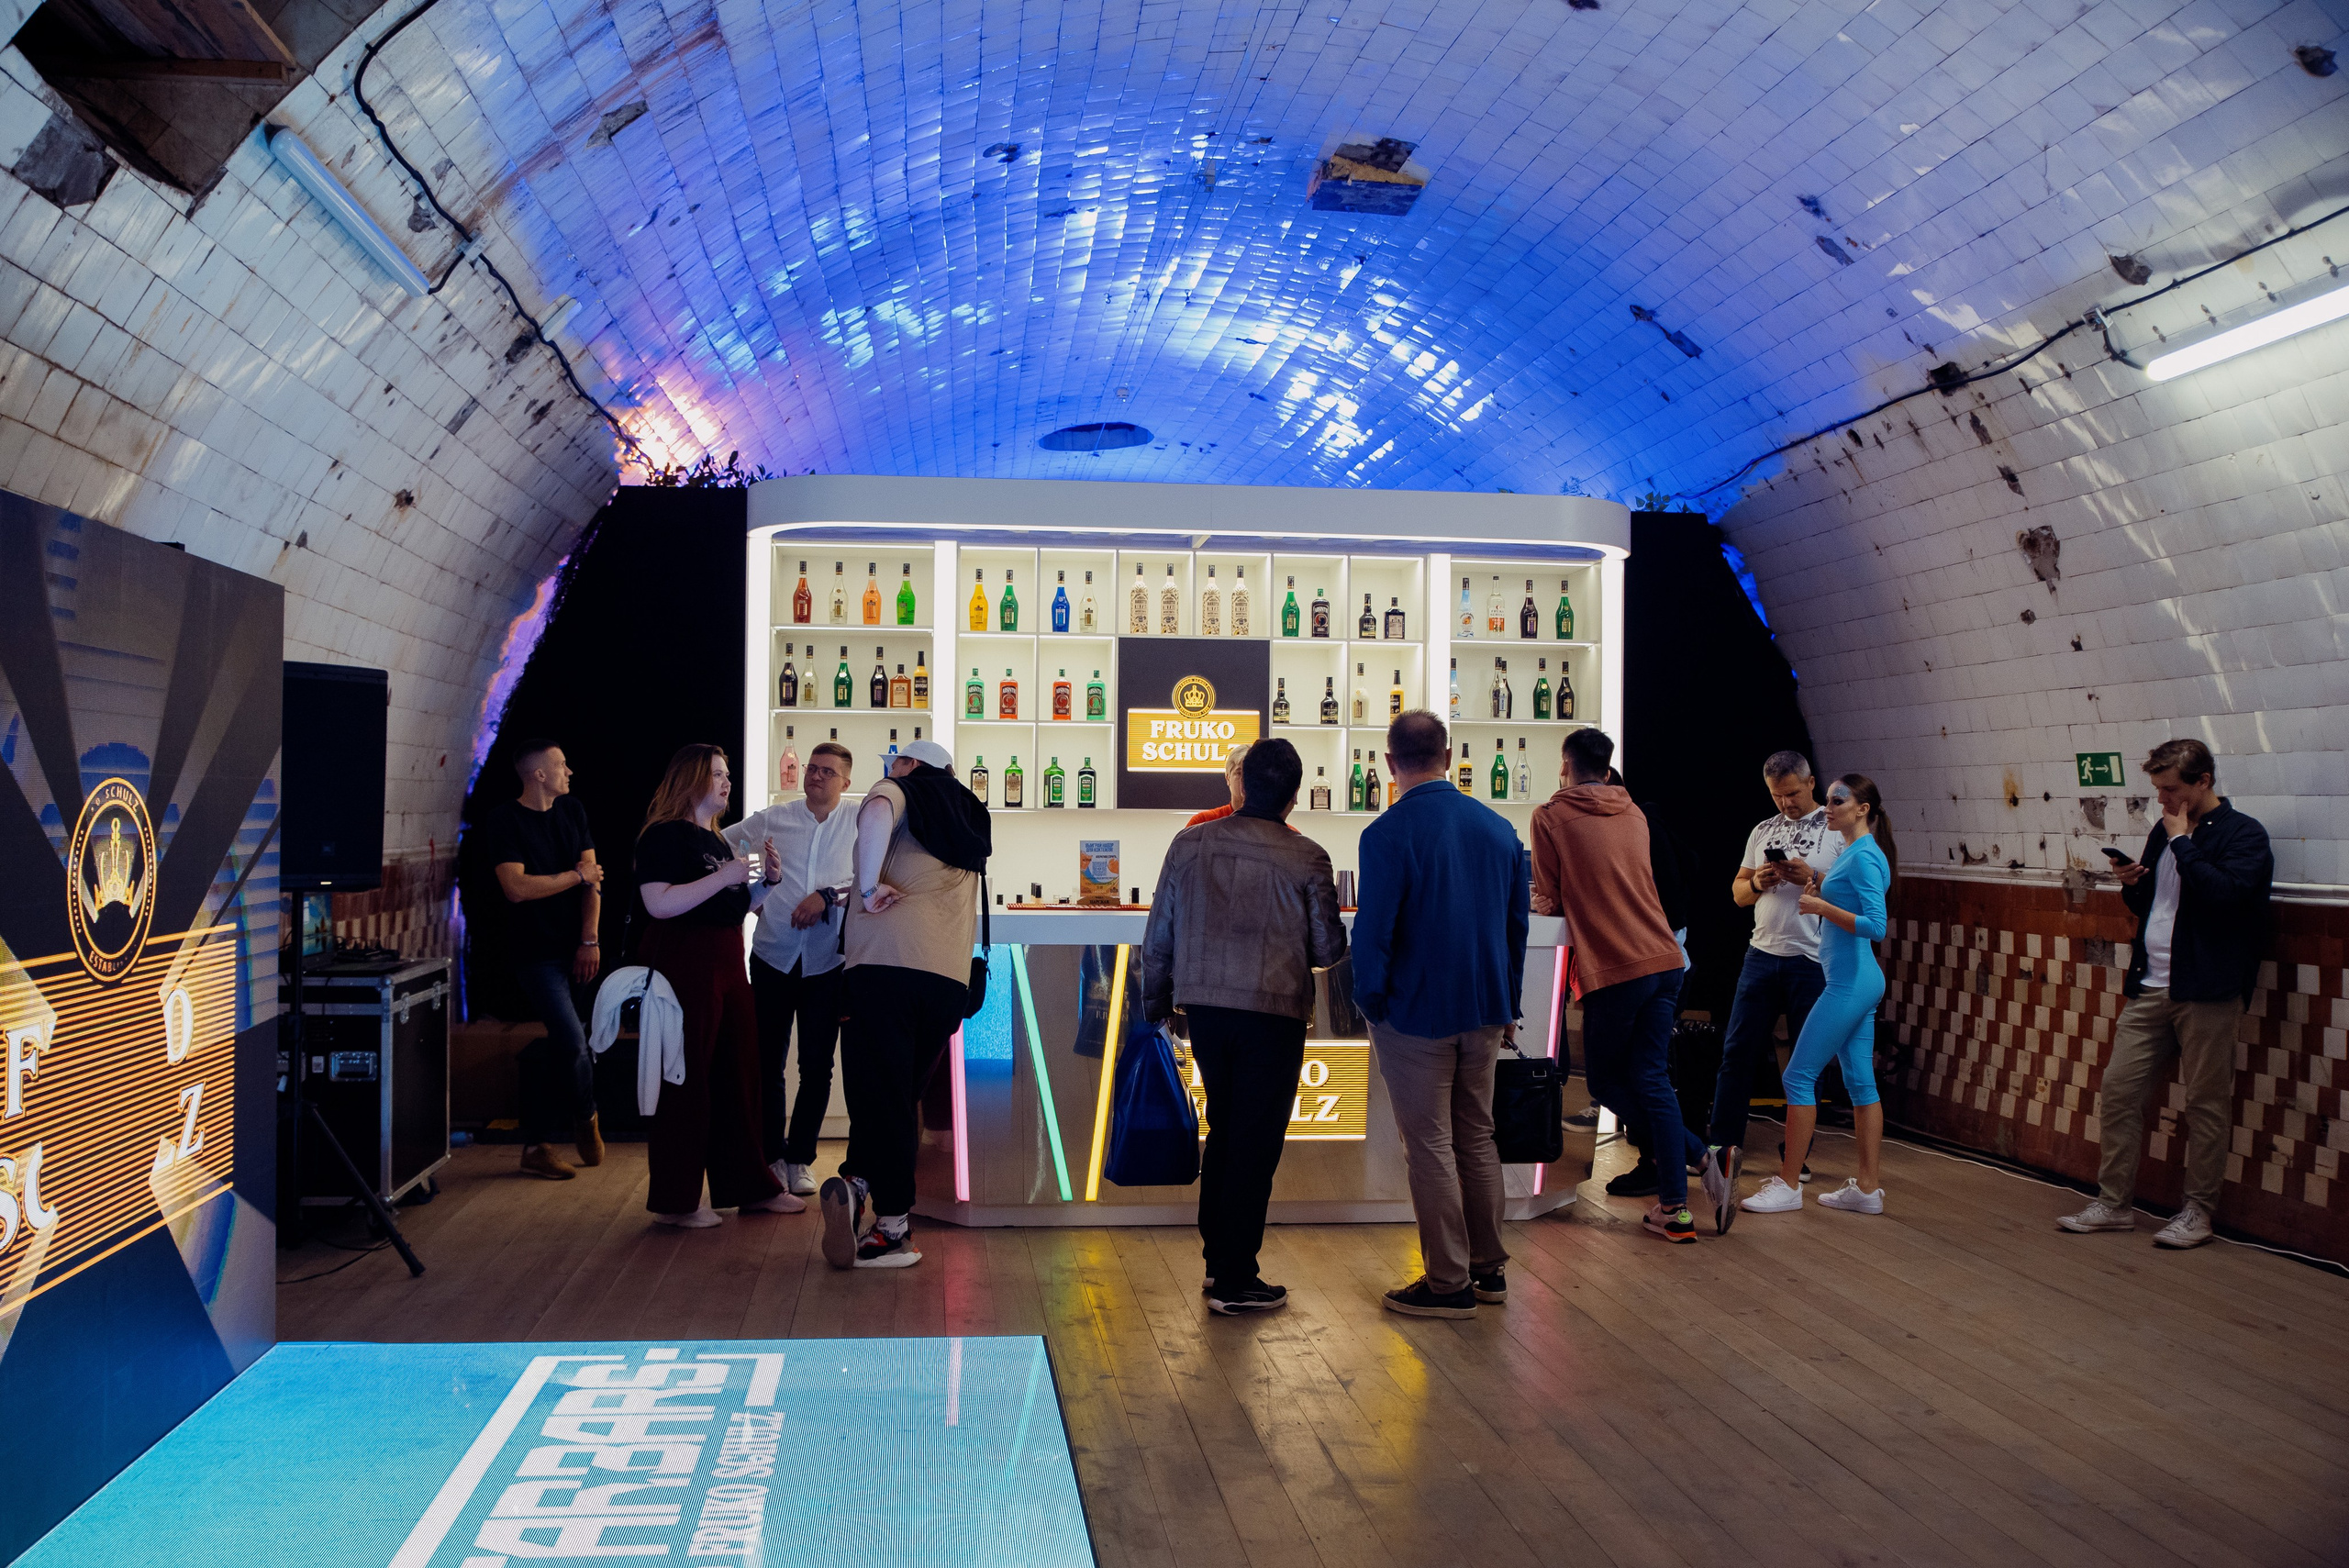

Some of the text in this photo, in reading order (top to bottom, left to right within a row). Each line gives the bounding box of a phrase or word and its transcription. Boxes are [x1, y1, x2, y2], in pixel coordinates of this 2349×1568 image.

[1150, 720, 1236, 740] FRUKO
[105, 785, 139, 814] SCHULZ
[688, 1411, 785, 1557] FRUKO SCHULZ
